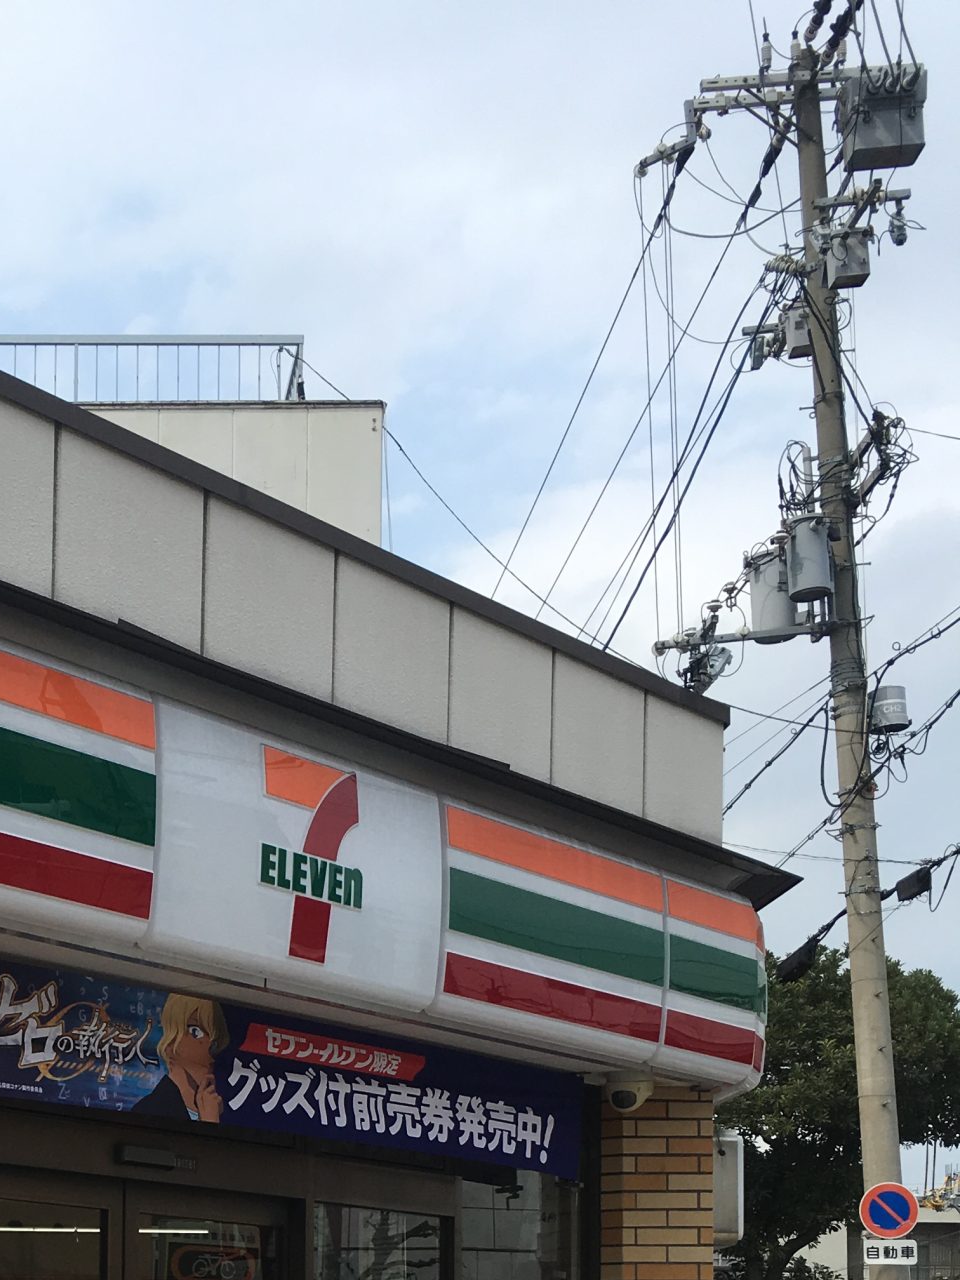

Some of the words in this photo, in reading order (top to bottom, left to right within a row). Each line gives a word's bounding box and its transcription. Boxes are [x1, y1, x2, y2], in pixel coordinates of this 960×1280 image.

[883, 702, 903, 713] CH2
[866, 1245, 915, 1260] 自動車
